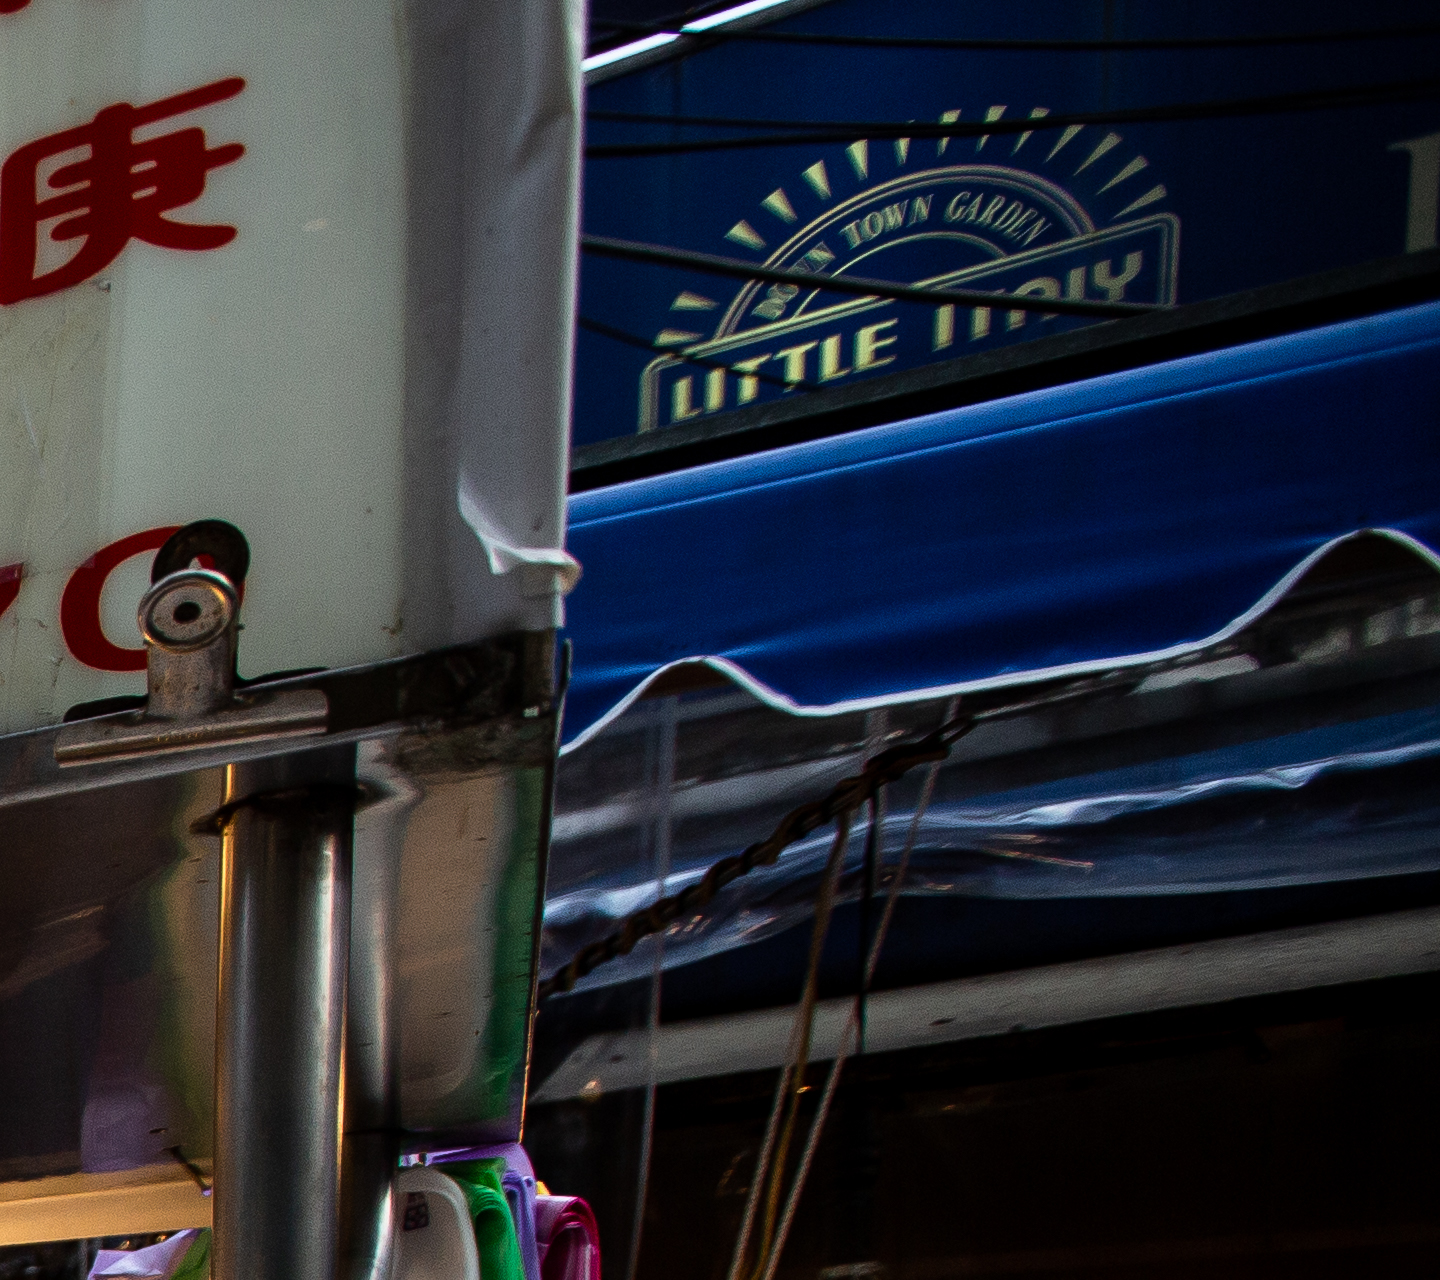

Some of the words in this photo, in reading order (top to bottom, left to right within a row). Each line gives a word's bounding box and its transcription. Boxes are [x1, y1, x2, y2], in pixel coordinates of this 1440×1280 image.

[838, 194, 935, 250] TOWN
[944, 190, 1053, 248] GARDEN
[670, 316, 899, 423] LITTLE
